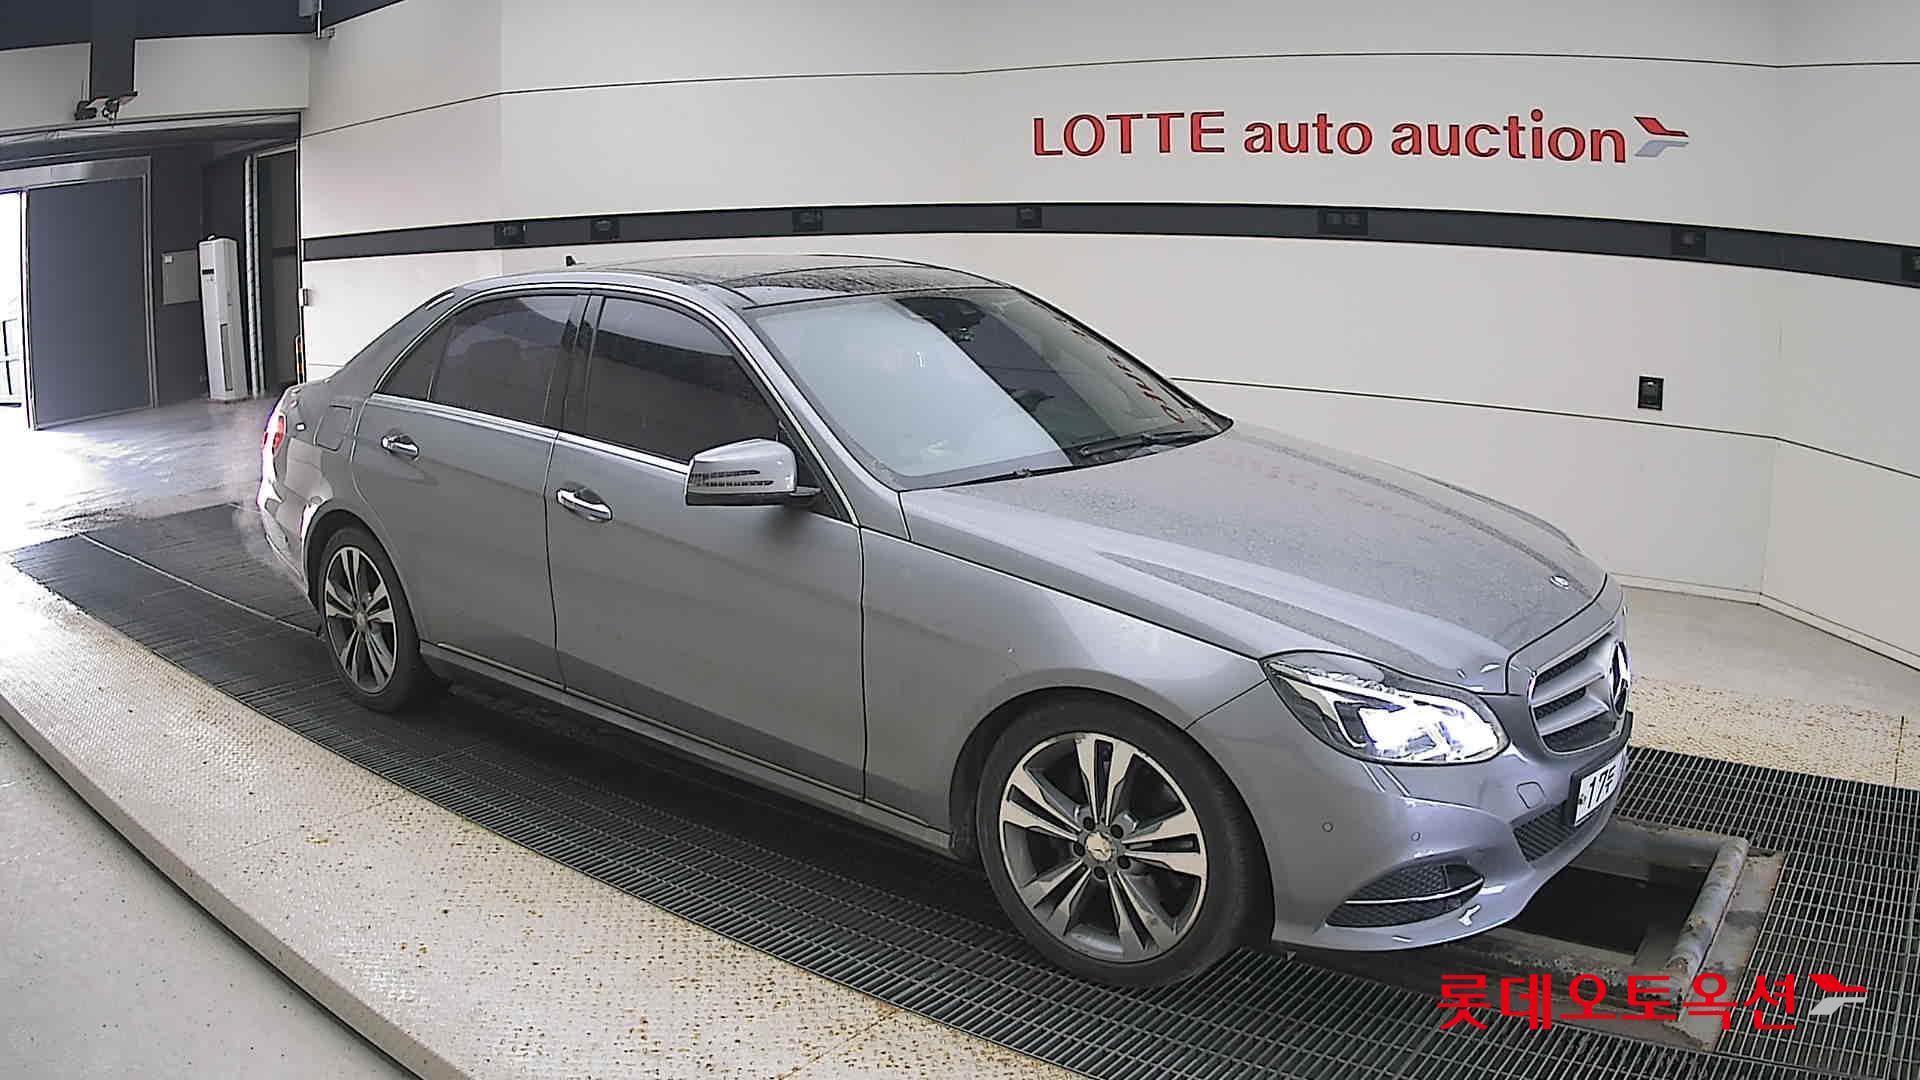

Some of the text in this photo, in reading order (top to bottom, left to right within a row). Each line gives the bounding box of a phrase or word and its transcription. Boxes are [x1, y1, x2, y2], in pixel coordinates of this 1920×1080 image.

[1033, 109, 1628, 164] LOTTE auto auction
